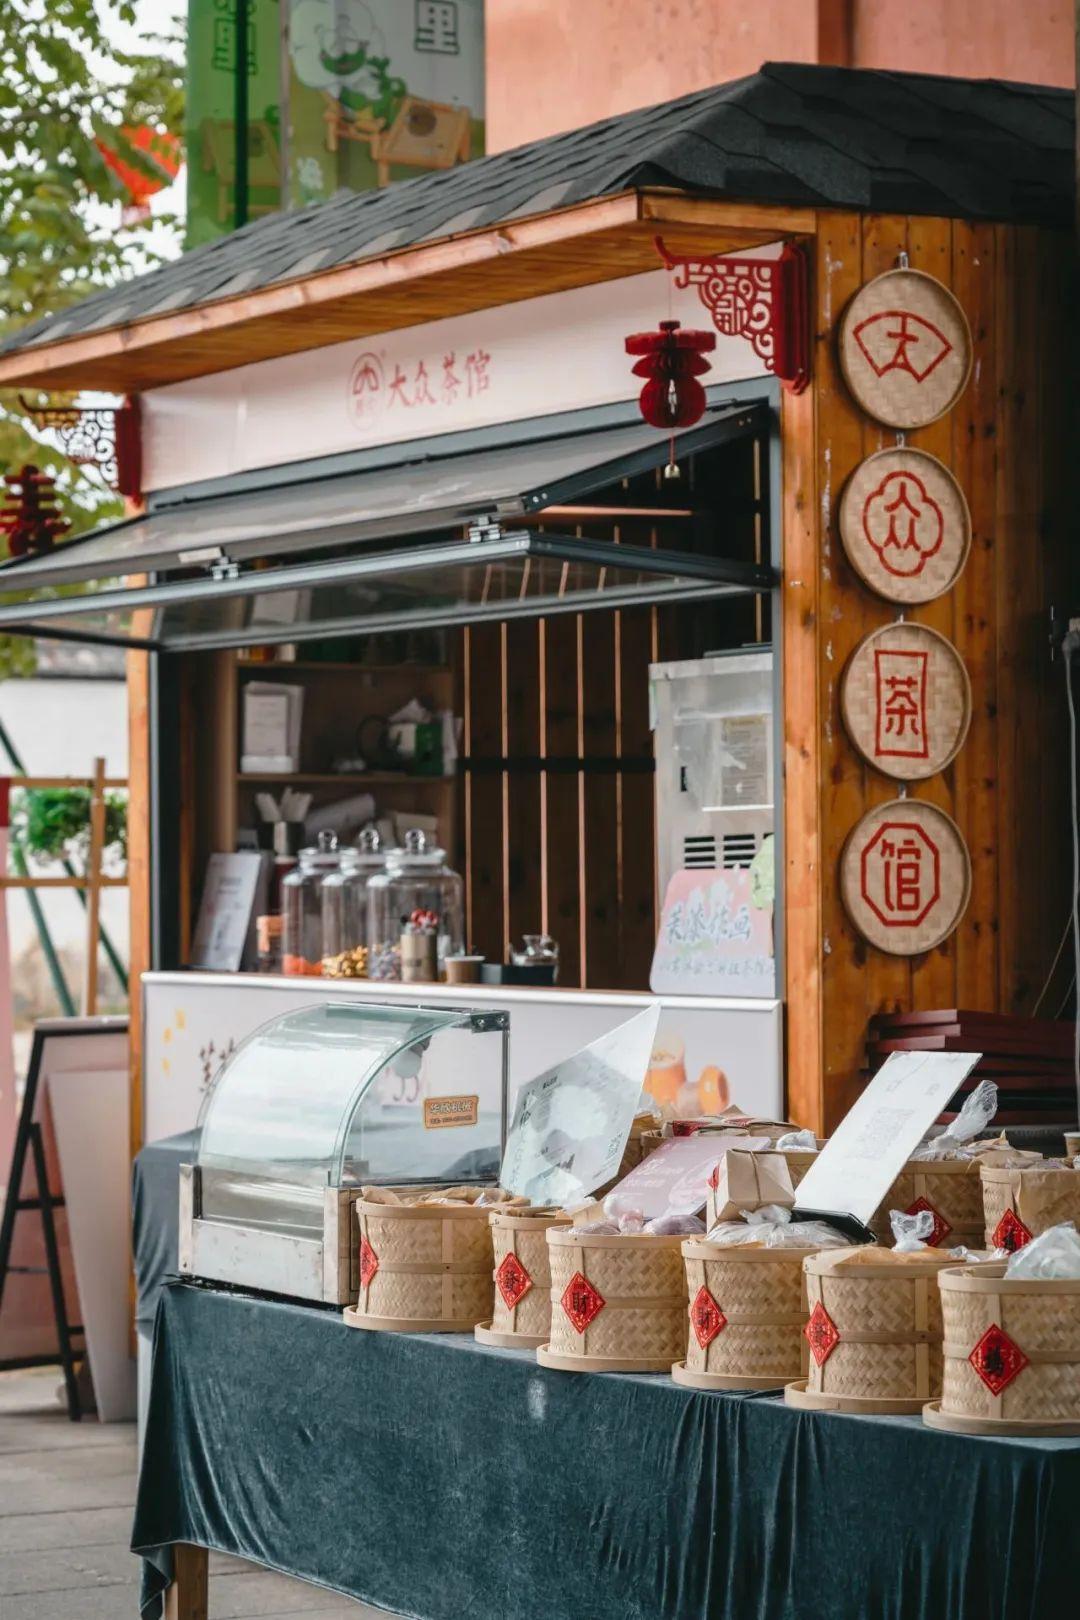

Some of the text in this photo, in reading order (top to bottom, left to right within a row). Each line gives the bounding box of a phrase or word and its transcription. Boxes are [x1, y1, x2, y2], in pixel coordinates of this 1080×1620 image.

[886, 312, 922, 376] 大
[388, 349, 491, 407] 大众茶馆
[884, 481, 921, 550] 众
[884, 676, 920, 736] 茶
[880, 838, 921, 912] 馆
